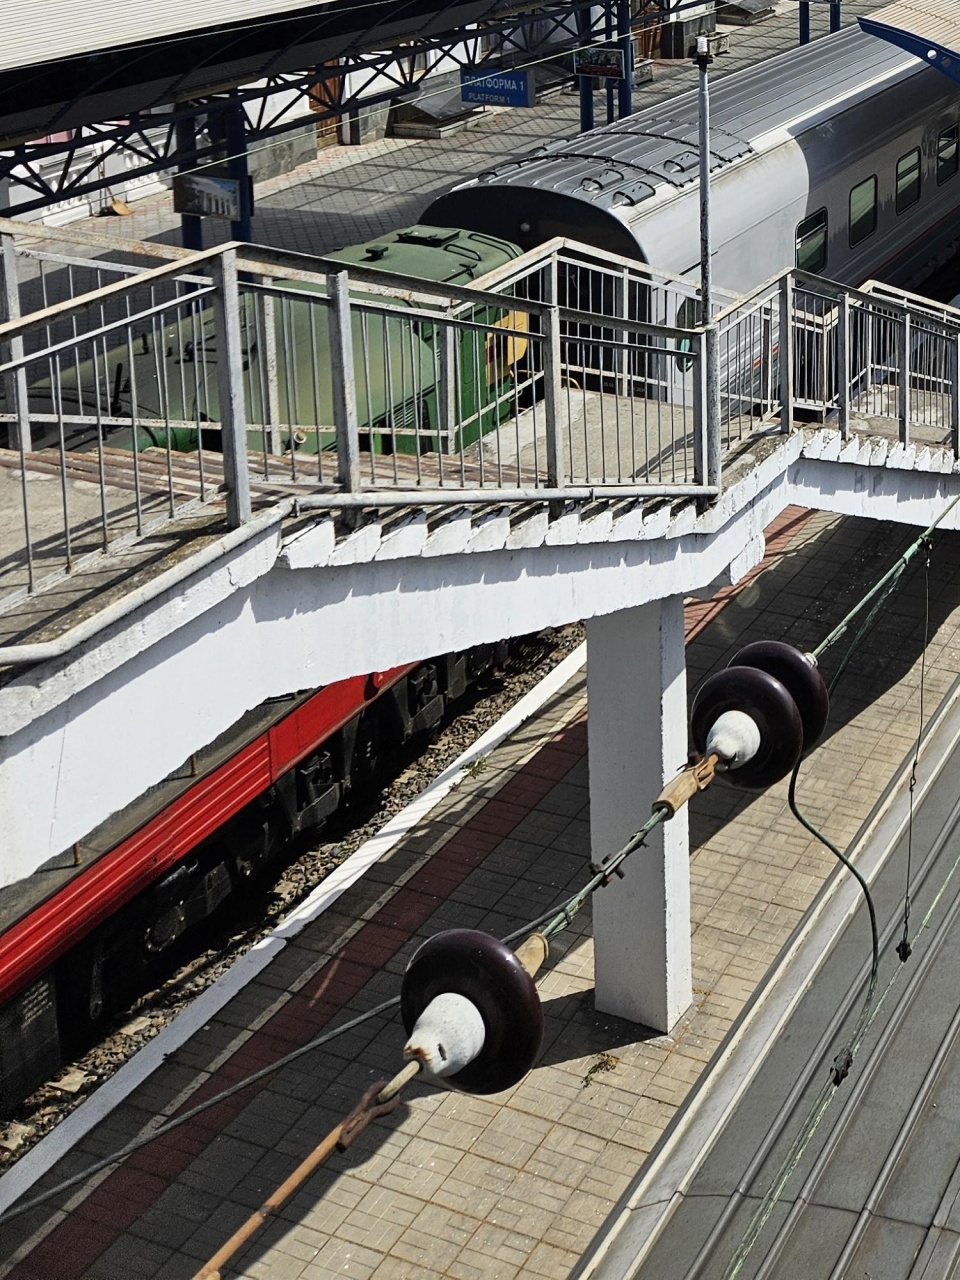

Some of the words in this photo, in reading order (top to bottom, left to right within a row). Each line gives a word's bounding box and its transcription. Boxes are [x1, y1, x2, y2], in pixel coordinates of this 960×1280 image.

[464, 75, 517, 90] ПЛАТФОРМА
[519, 81, 524, 91] 1
[468, 93, 505, 103] PLATFORM
